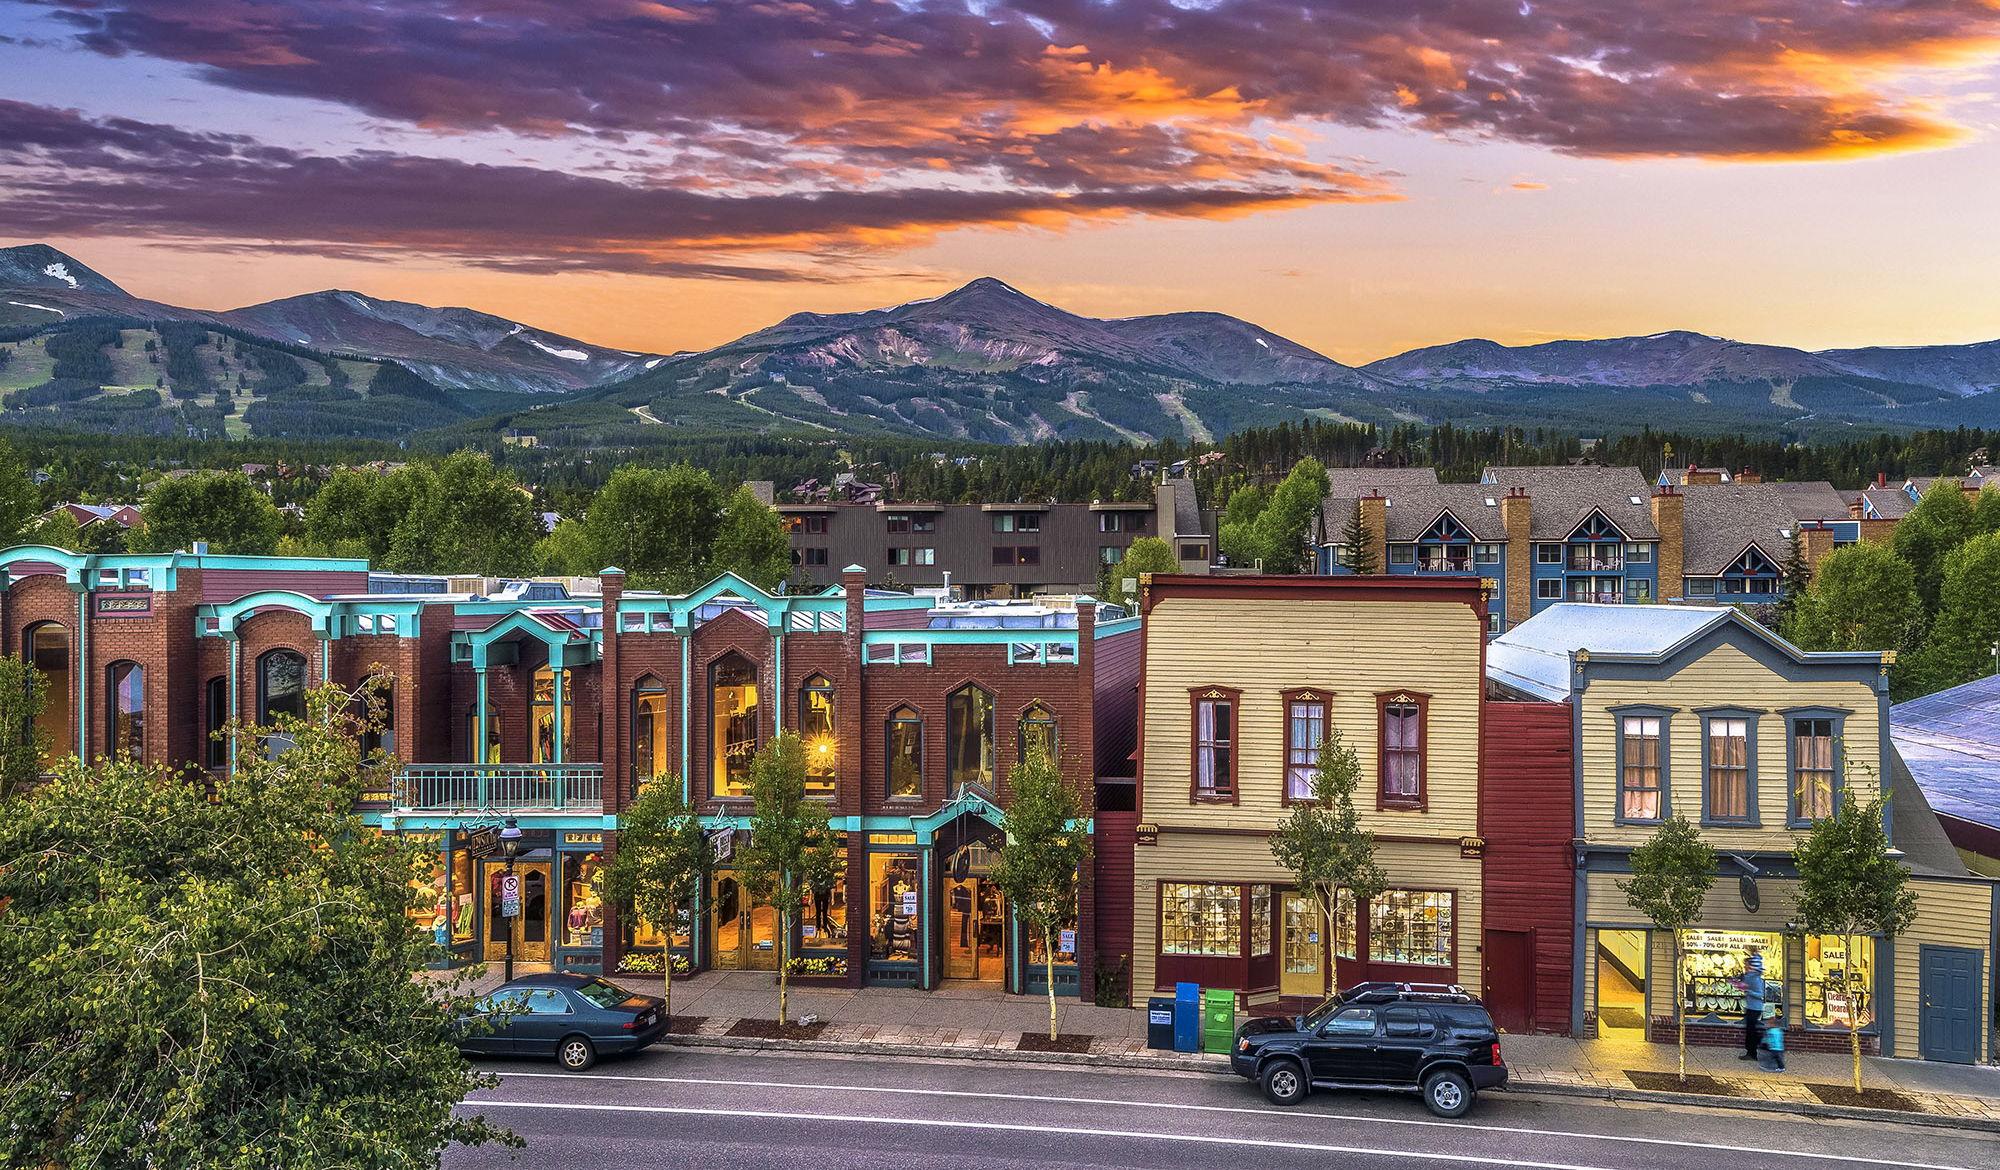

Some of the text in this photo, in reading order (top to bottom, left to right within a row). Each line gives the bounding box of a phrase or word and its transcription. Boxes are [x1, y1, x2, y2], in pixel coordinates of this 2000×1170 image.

[1823, 951, 1844, 959] SALE
[1827, 992, 1855, 1001] Clearae
[1828, 1003, 1856, 1013] Clearae
